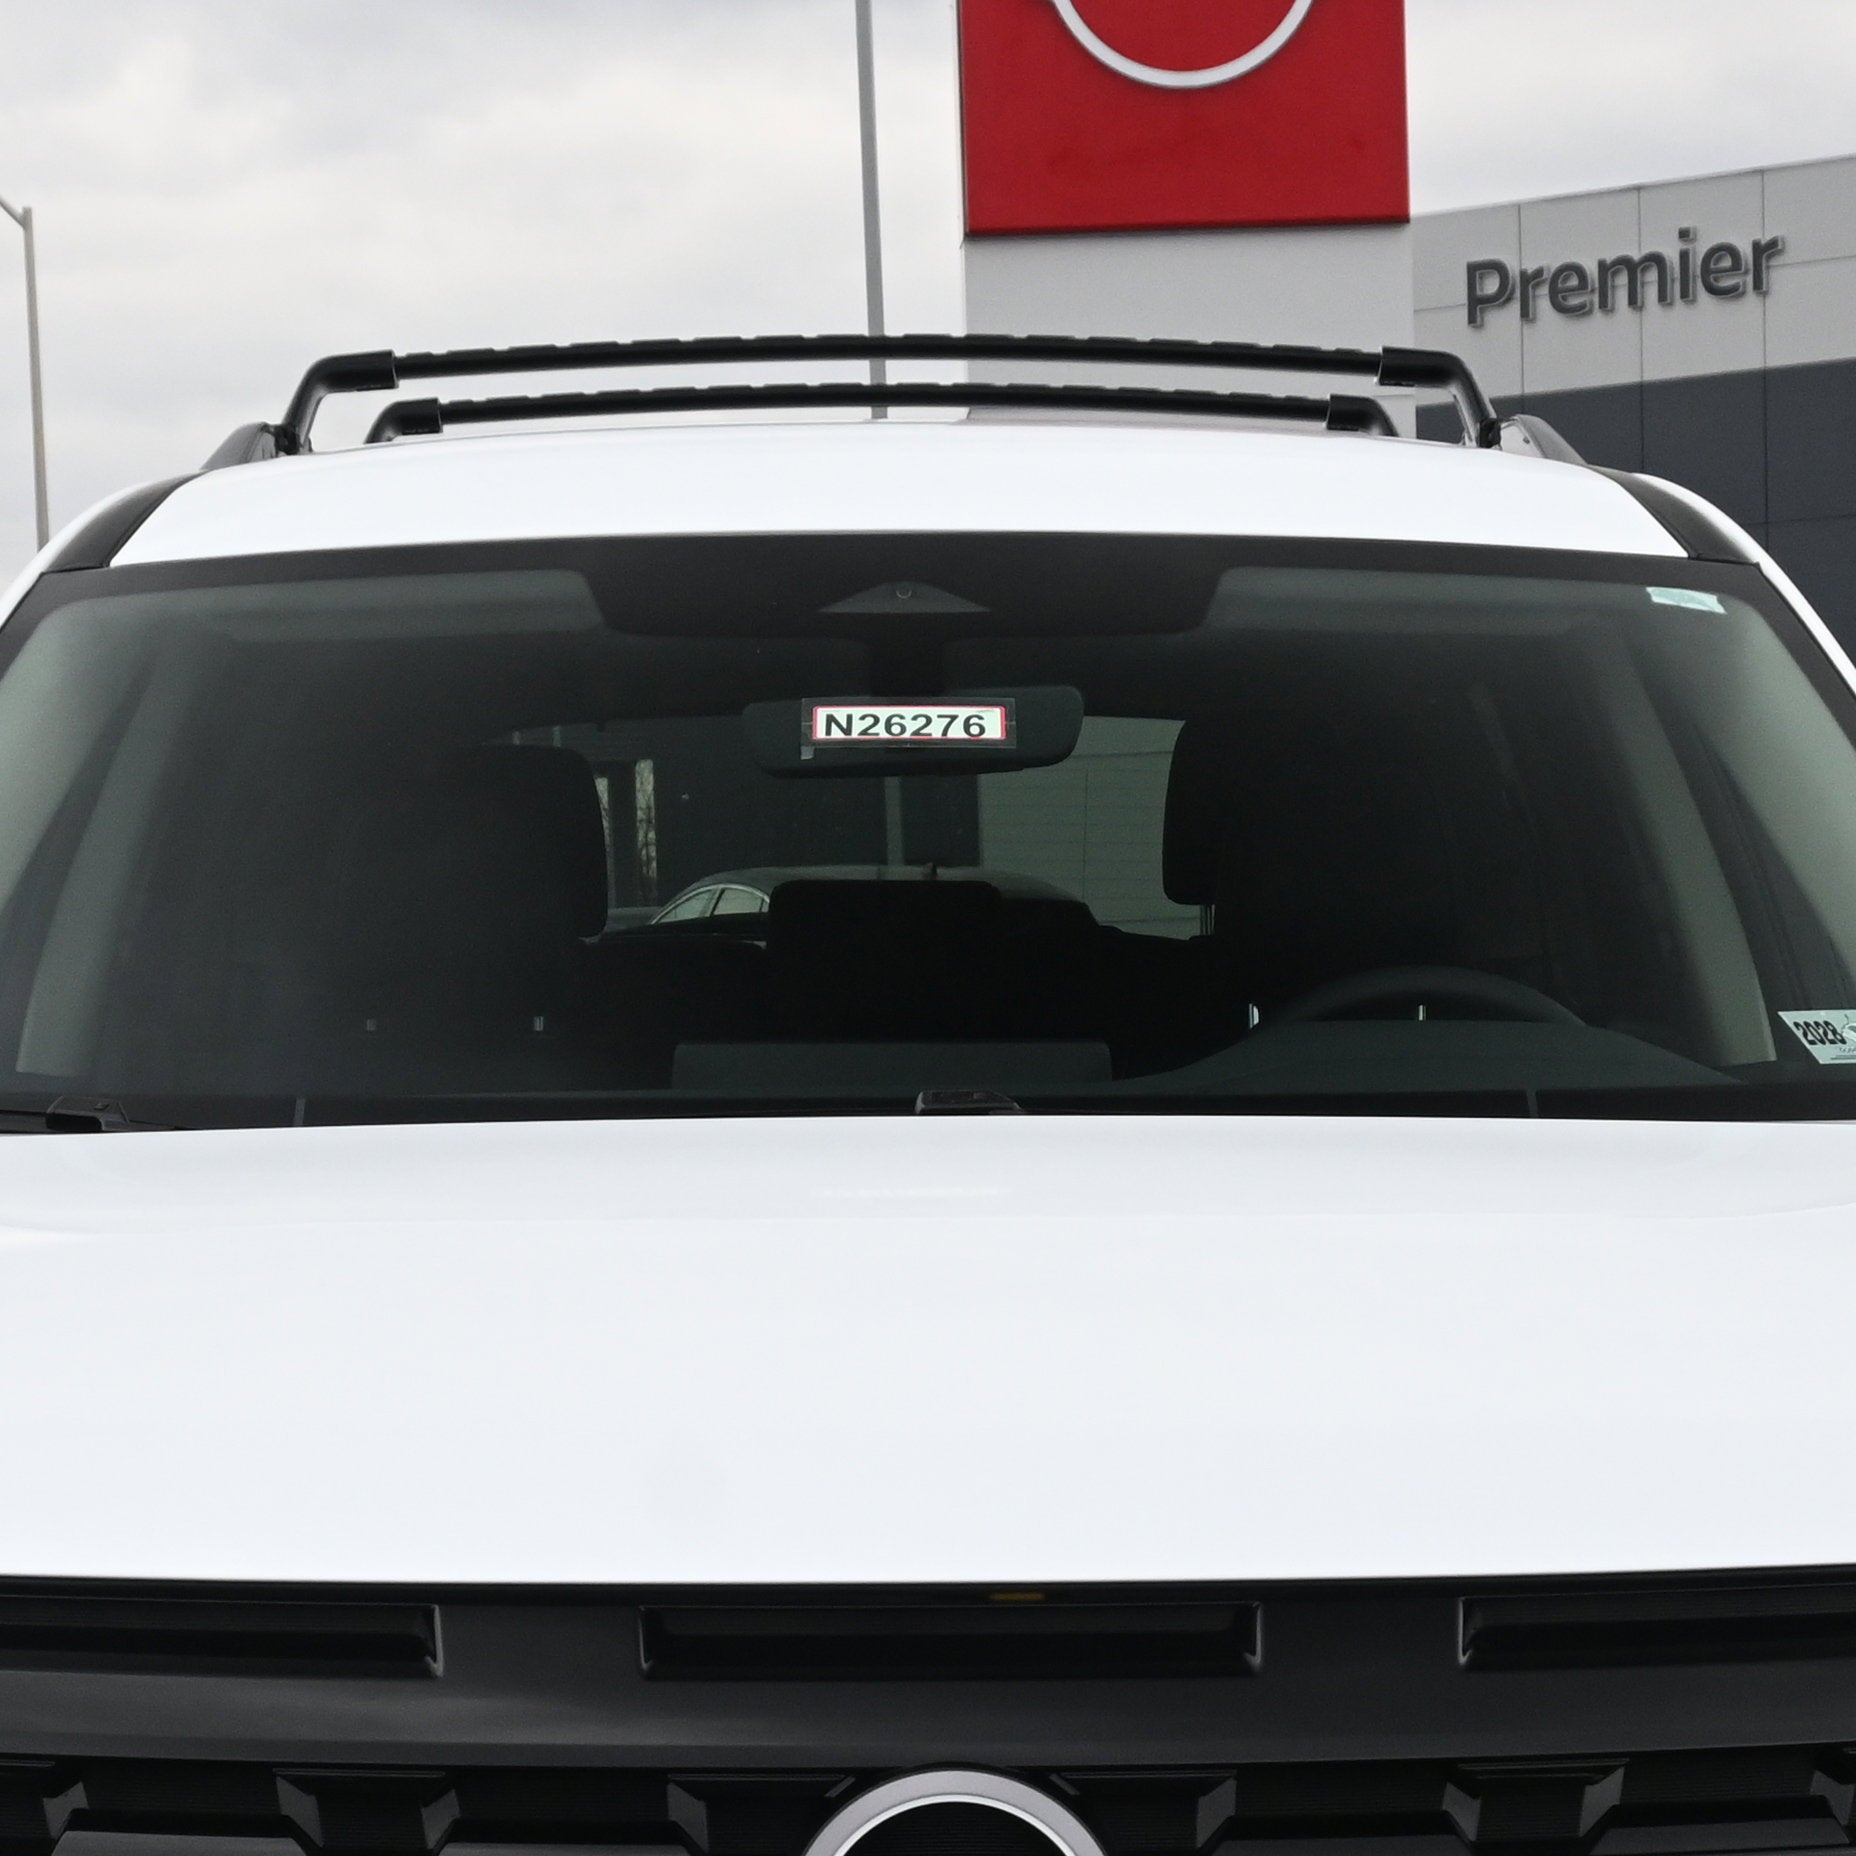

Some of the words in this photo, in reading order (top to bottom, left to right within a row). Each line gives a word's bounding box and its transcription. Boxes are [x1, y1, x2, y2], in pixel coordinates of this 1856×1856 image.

[1465, 225, 1786, 328] Premier
[823, 712, 987, 739] N26276
[1792, 1019, 1848, 1046] 2028
